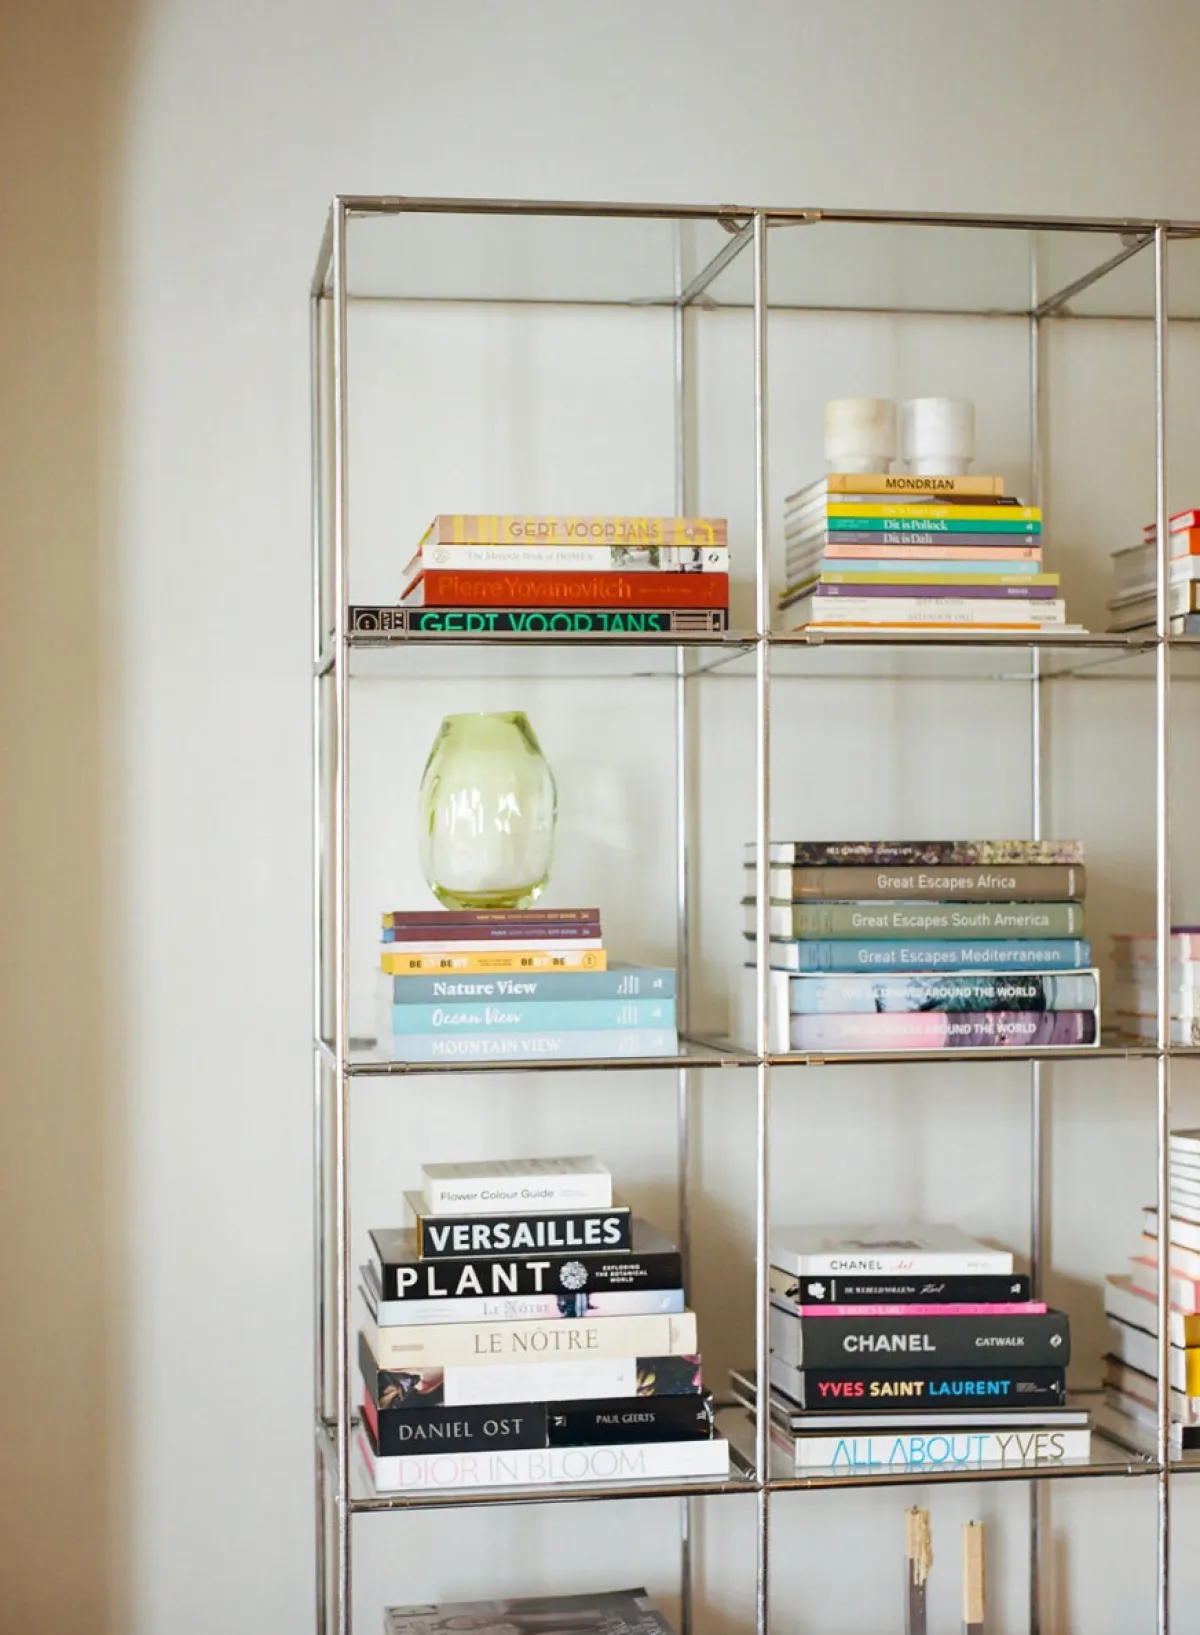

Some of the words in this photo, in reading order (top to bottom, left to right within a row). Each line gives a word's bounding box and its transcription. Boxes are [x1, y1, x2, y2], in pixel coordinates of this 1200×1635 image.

[885, 477, 955, 490] MONDRIAN
[508, 522, 558, 537] GERT
[564, 523, 660, 539] VOORJANS
[911, 519, 948, 531] Pollock
[438, 576, 503, 597] Pierre
[504, 576, 631, 599] Yovanovitch
[877, 874, 916, 889] Great
[918, 874, 974, 893] Escapes
[977, 874, 1016, 889] Africa
[852, 913, 889, 927] Great
[893, 913, 948, 931] Escapes
[951, 912, 991, 927] South
[994, 912, 1050, 927] America
[858, 949, 897, 964] Great
[899, 949, 957, 966] Escapes
[961, 948, 1061, 963] Mediterranean
[433, 981, 494, 996] Nature
[498, 980, 538, 995] View
[925, 986, 970, 998] AROUND
[973, 986, 994, 997] THE
[996, 986, 1037, 998] WORLD
[432, 1008, 482, 1027] Ocean
[486, 1008, 522, 1026] View
[973, 1023, 994, 1035] THE
[996, 1023, 1037, 1035] WORLD
[432, 1040, 519, 1055] MOUNTAIN
[522, 1039, 562, 1053] VIEW
[440, 1190, 478, 1203] Flower
[481, 1189, 519, 1201] Colour
[521, 1187, 554, 1200] Guide
[429, 1217, 622, 1252] VERSAILLES
[830, 1260, 884, 1271] CHANEL
[396, 1261, 551, 1298] PLANT
[475, 1334, 508, 1354] LE
[512, 1327, 599, 1353] NÔTRE
[843, 1333, 936, 1352] CHANEL
[975, 1336, 1025, 1347] CATWALK
[818, 1382, 864, 1397] YVES
[869, 1381, 925, 1397] SAINT
[929, 1380, 1011, 1396] LAURENT
[596, 1414, 620, 1424] PAUL
[622, 1412, 656, 1424] GEERTS
[399, 1421, 474, 1441] DANIEL
[483, 1418, 524, 1436] OST
[831, 1437, 882, 1467] ALL
[888, 1434, 990, 1466] ABOUT
[995, 1432, 1066, 1461] YVES
[398, 1455, 479, 1487] DIOR
[488, 1453, 518, 1482] IN
[527, 1449, 646, 1480] BLOOM
